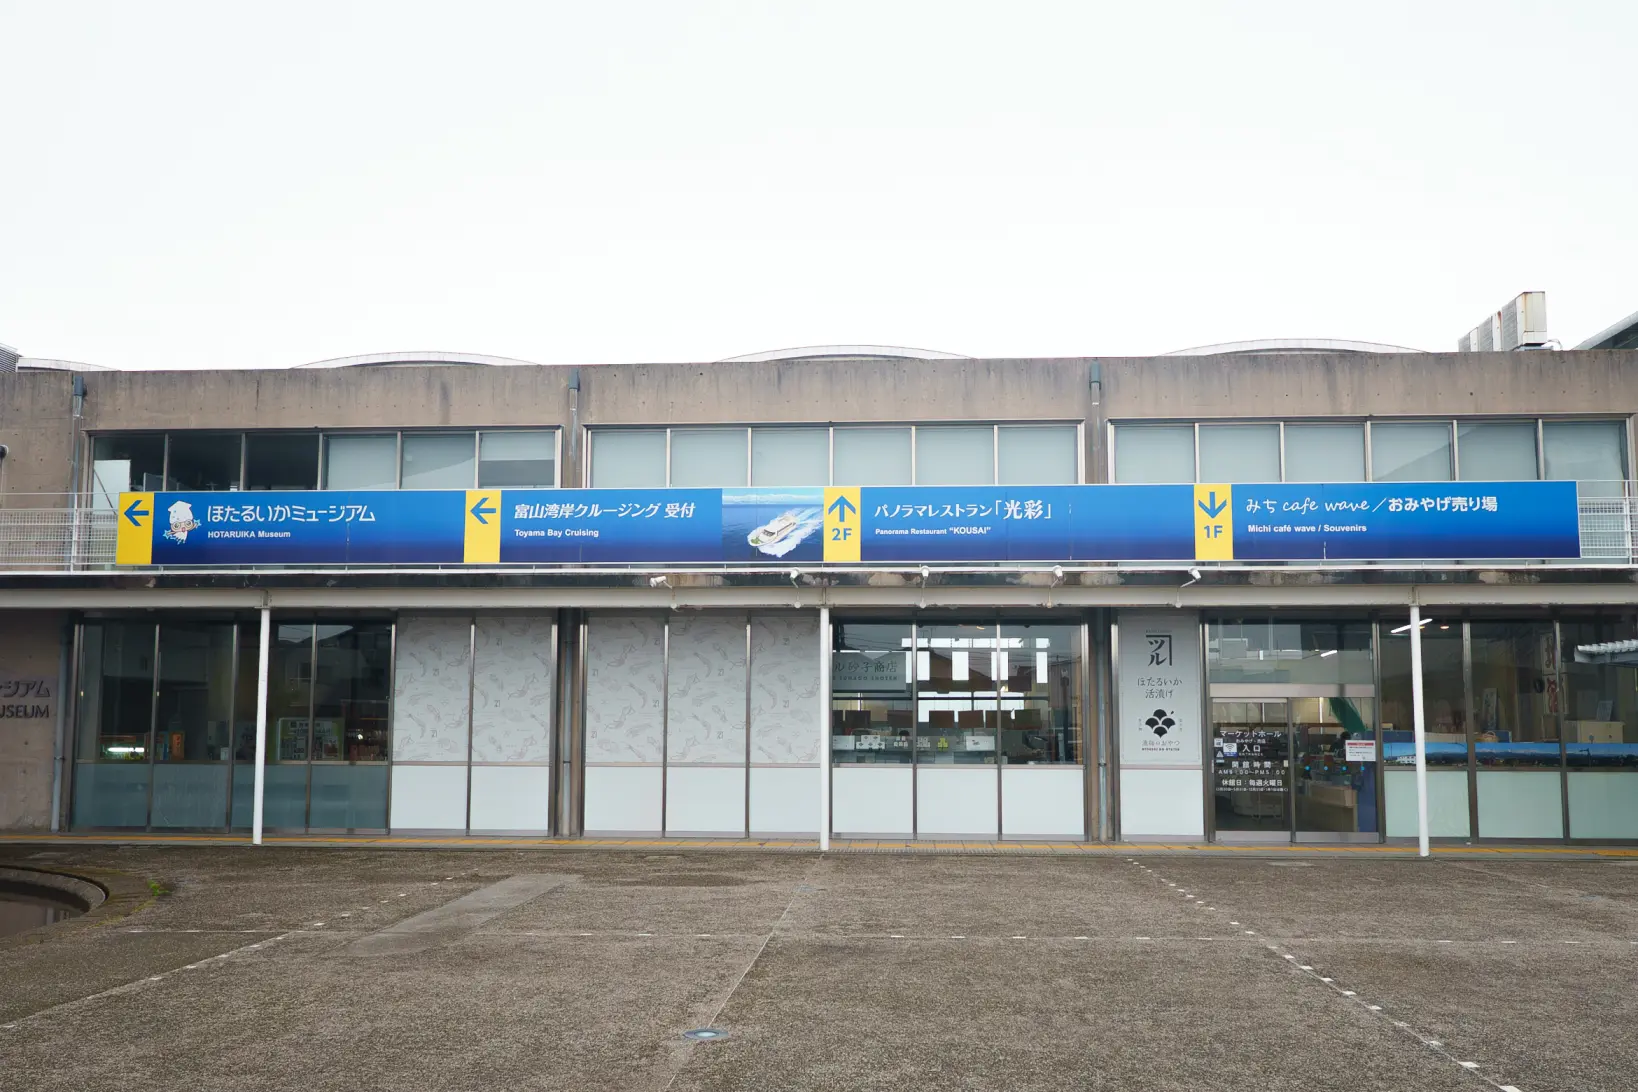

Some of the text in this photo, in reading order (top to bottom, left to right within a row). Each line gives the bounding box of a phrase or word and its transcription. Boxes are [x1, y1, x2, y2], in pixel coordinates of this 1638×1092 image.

[514, 502, 696, 519] 富山湾岸クルージング 受付
[874, 499, 1052, 520] パノラマレストラン「光彩」
[1246, 498, 1276, 513] みち
[1282, 497, 1318, 514] cafe
[1324, 499, 1370, 512] wave
[207, 504, 376, 523] ほたるいかミュージアム
[514, 529, 599, 538] Toyama Bay Cruising
[875, 528, 909, 536] Panorama
[1204, 525, 1223, 539] 1F
[1248, 524, 1272, 533] Michi
[1273, 524, 1292, 533] café
[1323, 524, 1367, 533] Souvenirs
[207, 530, 291, 538] HOTARUIKA Museum
[831, 528, 852, 541] 2F
[1137, 677, 1183, 687] ほたるいか
[1219, 730, 1282, 738] マーケットホール
[1242, 744, 1261, 753] 入口
